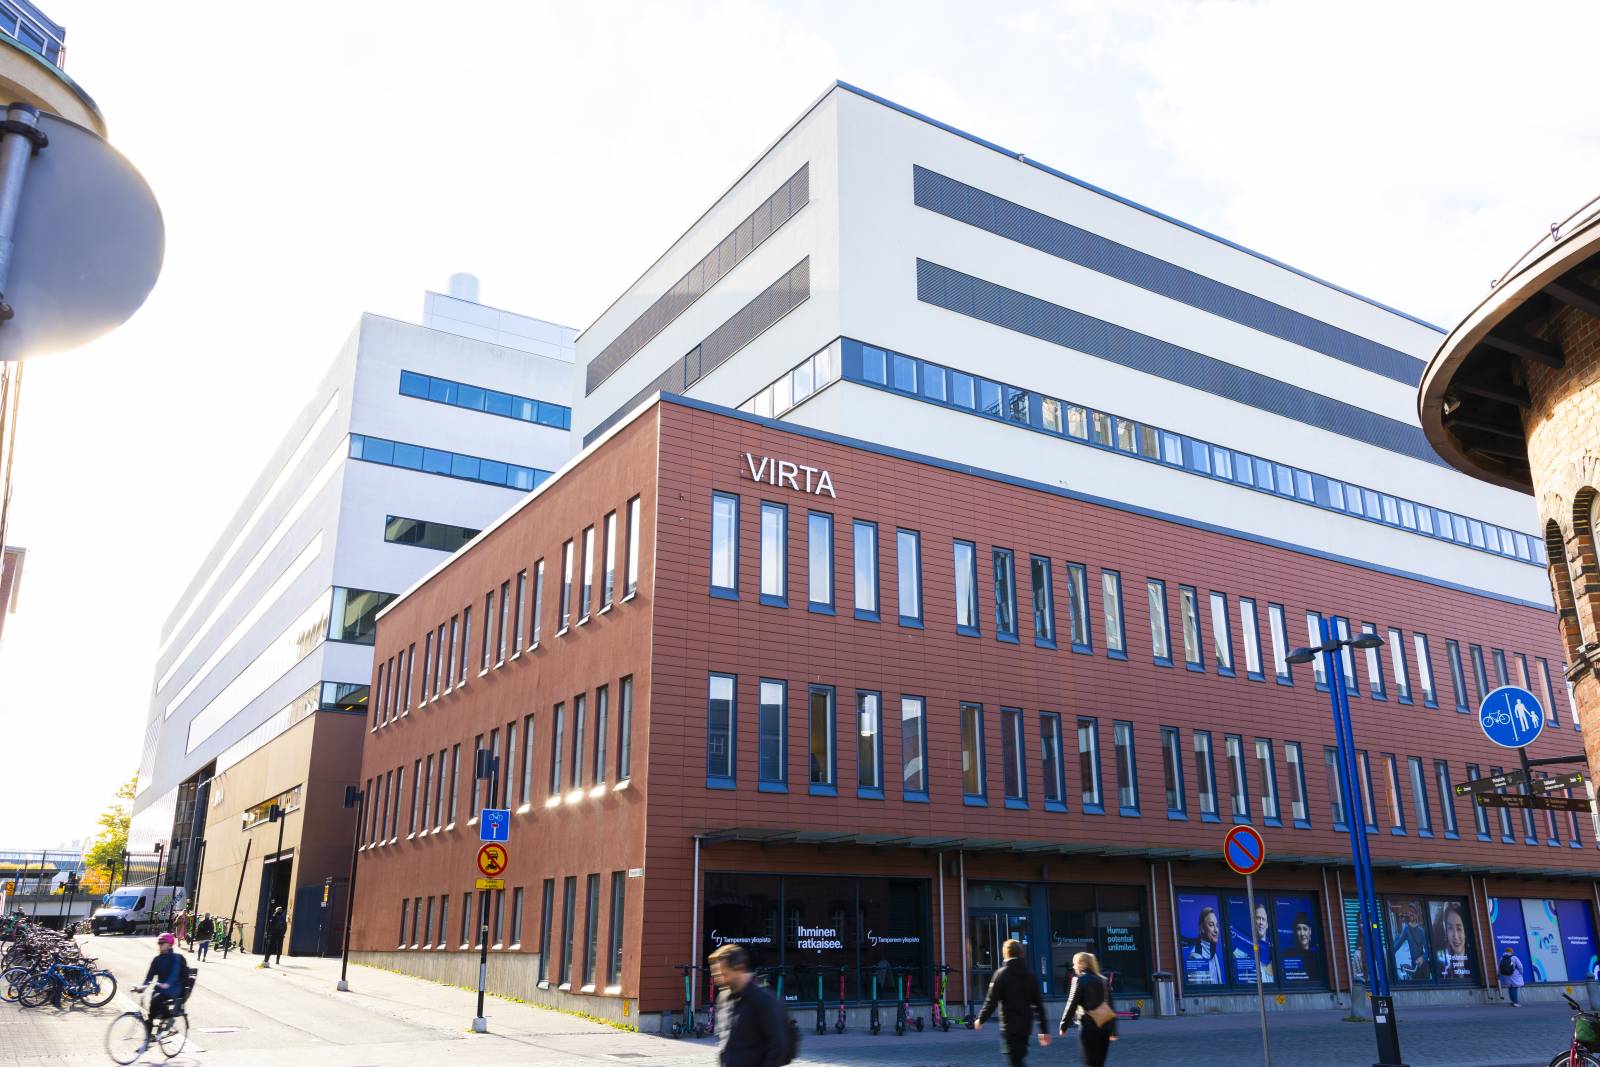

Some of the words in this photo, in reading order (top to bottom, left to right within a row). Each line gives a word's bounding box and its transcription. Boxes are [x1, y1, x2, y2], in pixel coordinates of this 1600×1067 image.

[746, 452, 837, 499] VIRTA
[797, 925, 836, 937] Ihminen
[1106, 926, 1128, 934] Human
[797, 937, 843, 949] ratkaisee.
[1107, 934, 1134, 944] potential
